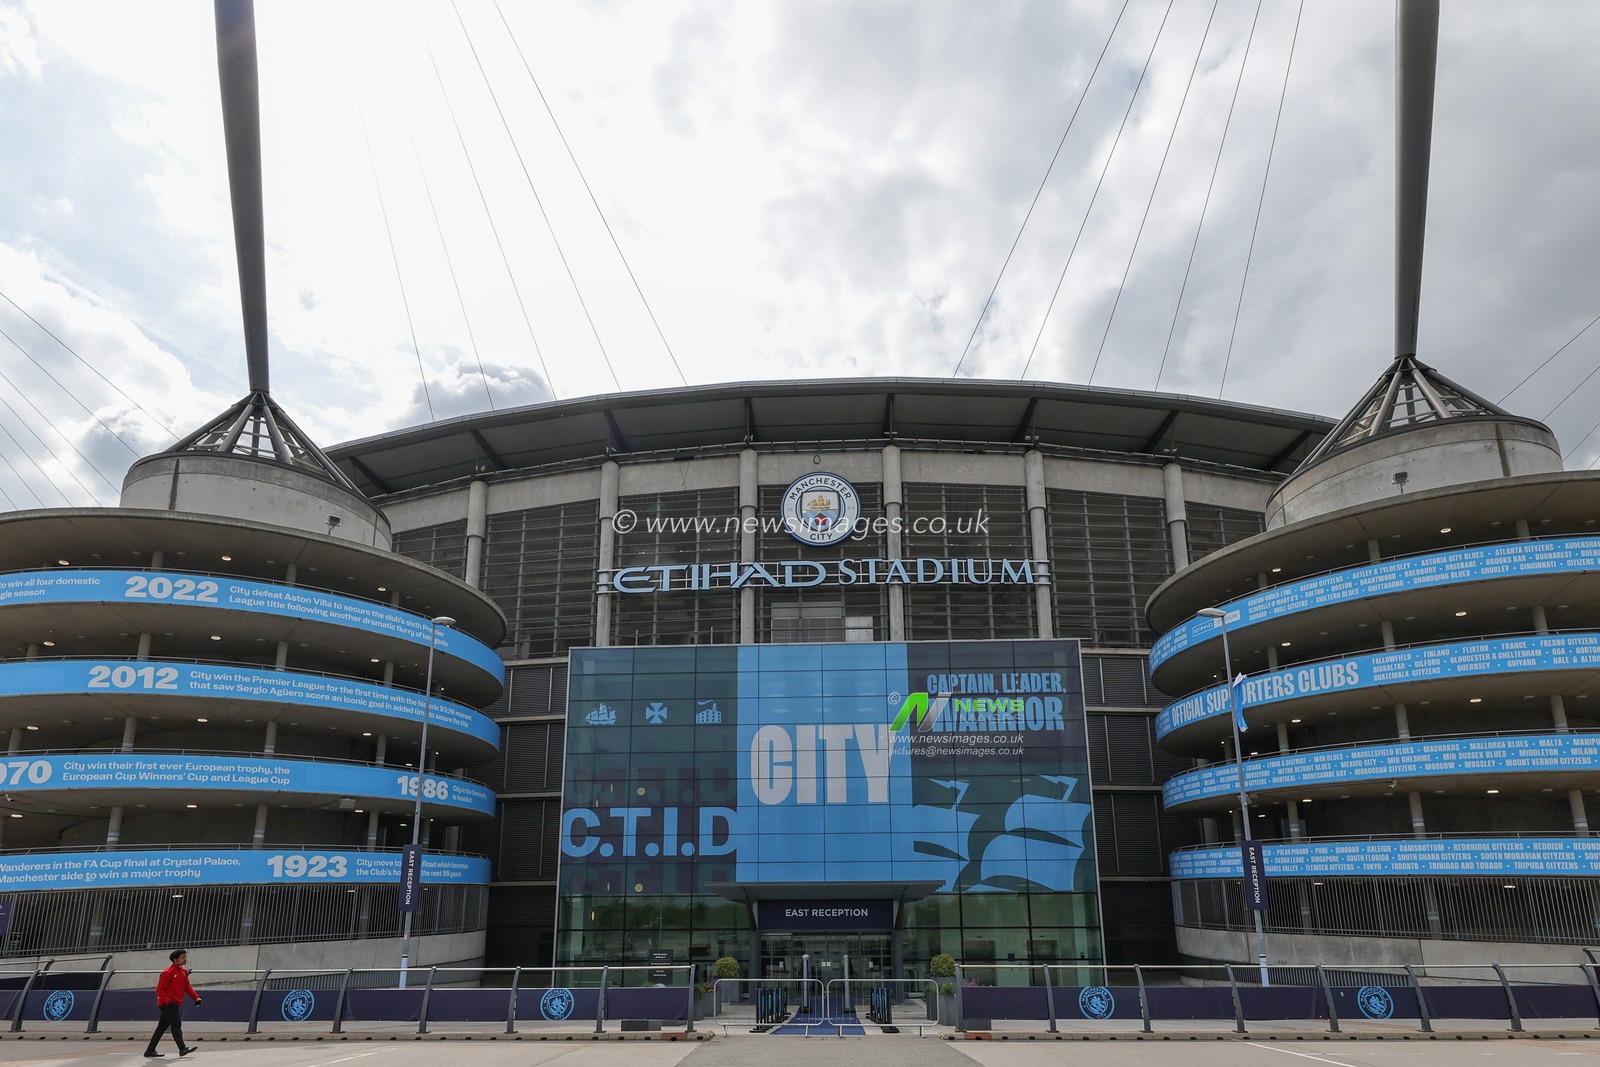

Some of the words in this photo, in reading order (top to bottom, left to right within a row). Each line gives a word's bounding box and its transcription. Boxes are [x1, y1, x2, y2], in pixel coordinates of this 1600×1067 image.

[790, 478, 851, 500] MANCHESTER
[1353, 569, 1372, 579] ASTLEY
[1380, 562, 1410, 574] TYLDESLEY
[1421, 556, 1447, 566] ASTORIA
[1449, 554, 1462, 562] CITY
[1464, 551, 1484, 560] BLUES
[1495, 547, 1522, 556] ATLANTA
[1524, 544, 1554, 553] CITYZENS
[1446, 561, 1476, 571] BRISBANE
[1486, 556, 1512, 565] BROOKS
[1535, 551, 1572, 560] BUCHAREST
[1451, 570, 1470, 579] BLUES
[1481, 565, 1509, 574] CHORLEY
[613, 560, 827, 593] ETIHAD
[838, 558, 1034, 585] STADIUM
[125, 576, 219, 603] 2022
[230, 586, 250, 596] City
[252, 588, 282, 600] defeat
[284, 593, 311, 604] Aston
[313, 597, 332, 608] Villa
[344, 606, 370, 616] secure
[372, 610, 384, 618] the
[230, 595, 265, 606] League
[267, 600, 285, 609] title
[287, 603, 328, 617] following
[330, 611, 361, 622] another
[363, 617, 395, 630] dramatic
[1372, 654, 1412, 664] FALLOWFIELD
[1424, 649, 1450, 658] FINLAND
[1502, 642, 1527, 650] FRANCE
[1540, 639, 1565, 647] FRESNO
[1450, 654, 1490, 664] GLOUCESTER
[1498, 649, 1542, 659] CHELTENHAM
[88, 665, 179, 690] 2012
[190, 671, 211, 680] City
[253, 676, 291, 686] Premier
[292, 680, 325, 690] League
[326, 684, 338, 692] for
[354, 689, 371, 697] first
[372, 692, 389, 700] time
[390, 695, 405, 703] with
[927, 674, 999, 696] CAPTAIN,
[1002, 672, 1066, 694] LEADER,
[189, 681, 211, 689] that
[236, 684, 268, 694] Sergio
[269, 687, 304, 697] Agüero
[306, 692, 330, 701] score
[344, 696, 367, 706] iconic
[368, 700, 384, 708] goal
[393, 704, 414, 714] added
[1171, 696, 1206, 726] OFFICIAL
[1298, 661, 1359, 693] CLUBS
[1352, 748, 1394, 758] MACCLESFIELD
[1470, 741, 1506, 750] MALLORCA
[1519, 748, 1558, 757] MIDDLETON
[64, 762, 84, 771] City
[109, 761, 133, 770] their
[135, 762, 157, 770] first
[186, 763, 235, 772] European
[237, 765, 272, 775] trophy,
[274, 766, 290, 775] the
[751, 724, 896, 805] CITY
[1388, 764, 1416, 773] CITYZENS
[1425, 762, 1454, 770] MOSCOW
[1465, 760, 1495, 768] MOSSLEY
[63, 772, 112, 782] European
[115, 772, 136, 781] Cup
[139, 772, 186, 780] Winners'
[188, 773, 208, 782] Cup
[210, 773, 230, 782] and
[232, 775, 269, 785] League
[270, 776, 290, 786] Cup
[397, 776, 448, 800] 1986
[53, 861, 62, 869] in
[64, 861, 82, 869] the
[84, 860, 98, 868] FA
[100, 859, 122, 869] Cup
[124, 859, 147, 867] final
[163, 858, 202, 867] Crystal
[204, 857, 241, 866] Palace,
[61, 872, 83, 880] side
[130, 869, 163, 879] major
[164, 868, 201, 878] trophy
[267, 855, 348, 878] 1923
[357, 859, 372, 867] City
[405, 869, 413, 905] RECEPTION
[1251, 865, 1260, 904] RECEPTION
[785, 909, 809, 917] EAST
[812, 909, 868, 917] RECEPTION
